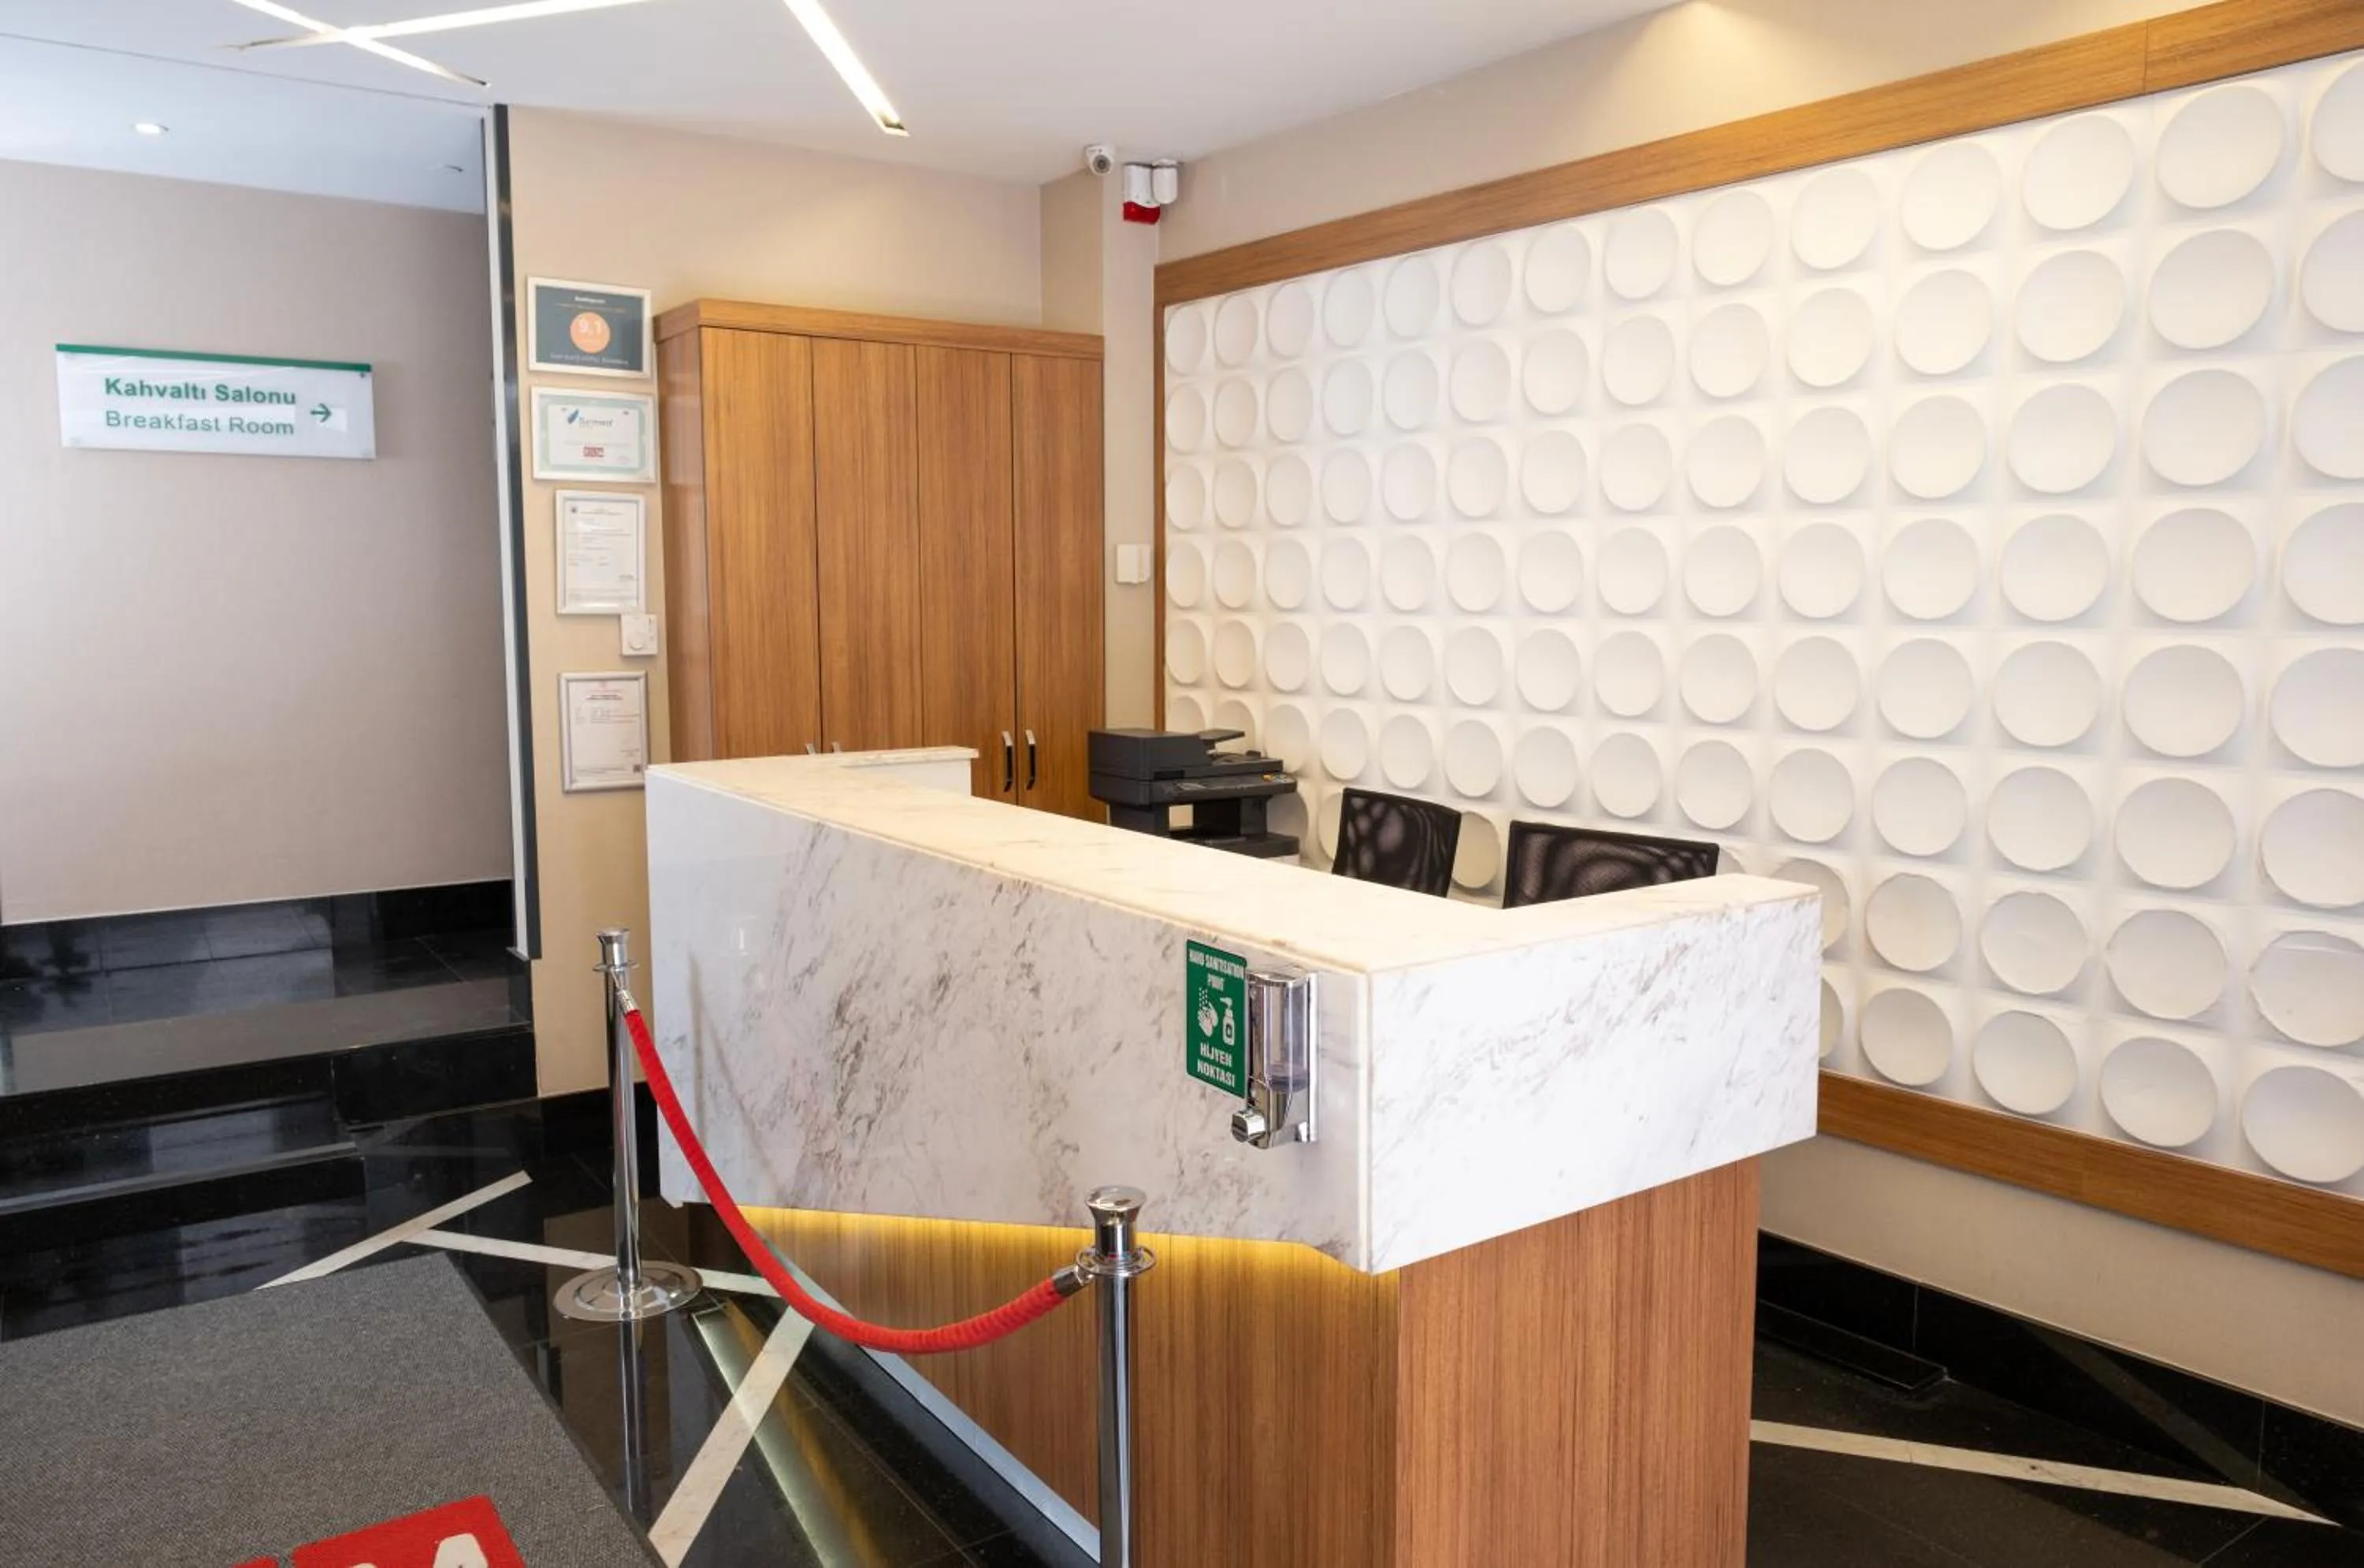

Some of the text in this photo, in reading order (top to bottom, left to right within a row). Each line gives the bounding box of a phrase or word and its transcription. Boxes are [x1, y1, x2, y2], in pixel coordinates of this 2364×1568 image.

[105, 377, 296, 404] Kahvaltı Salonu
[106, 410, 294, 436] Breakfast Room
